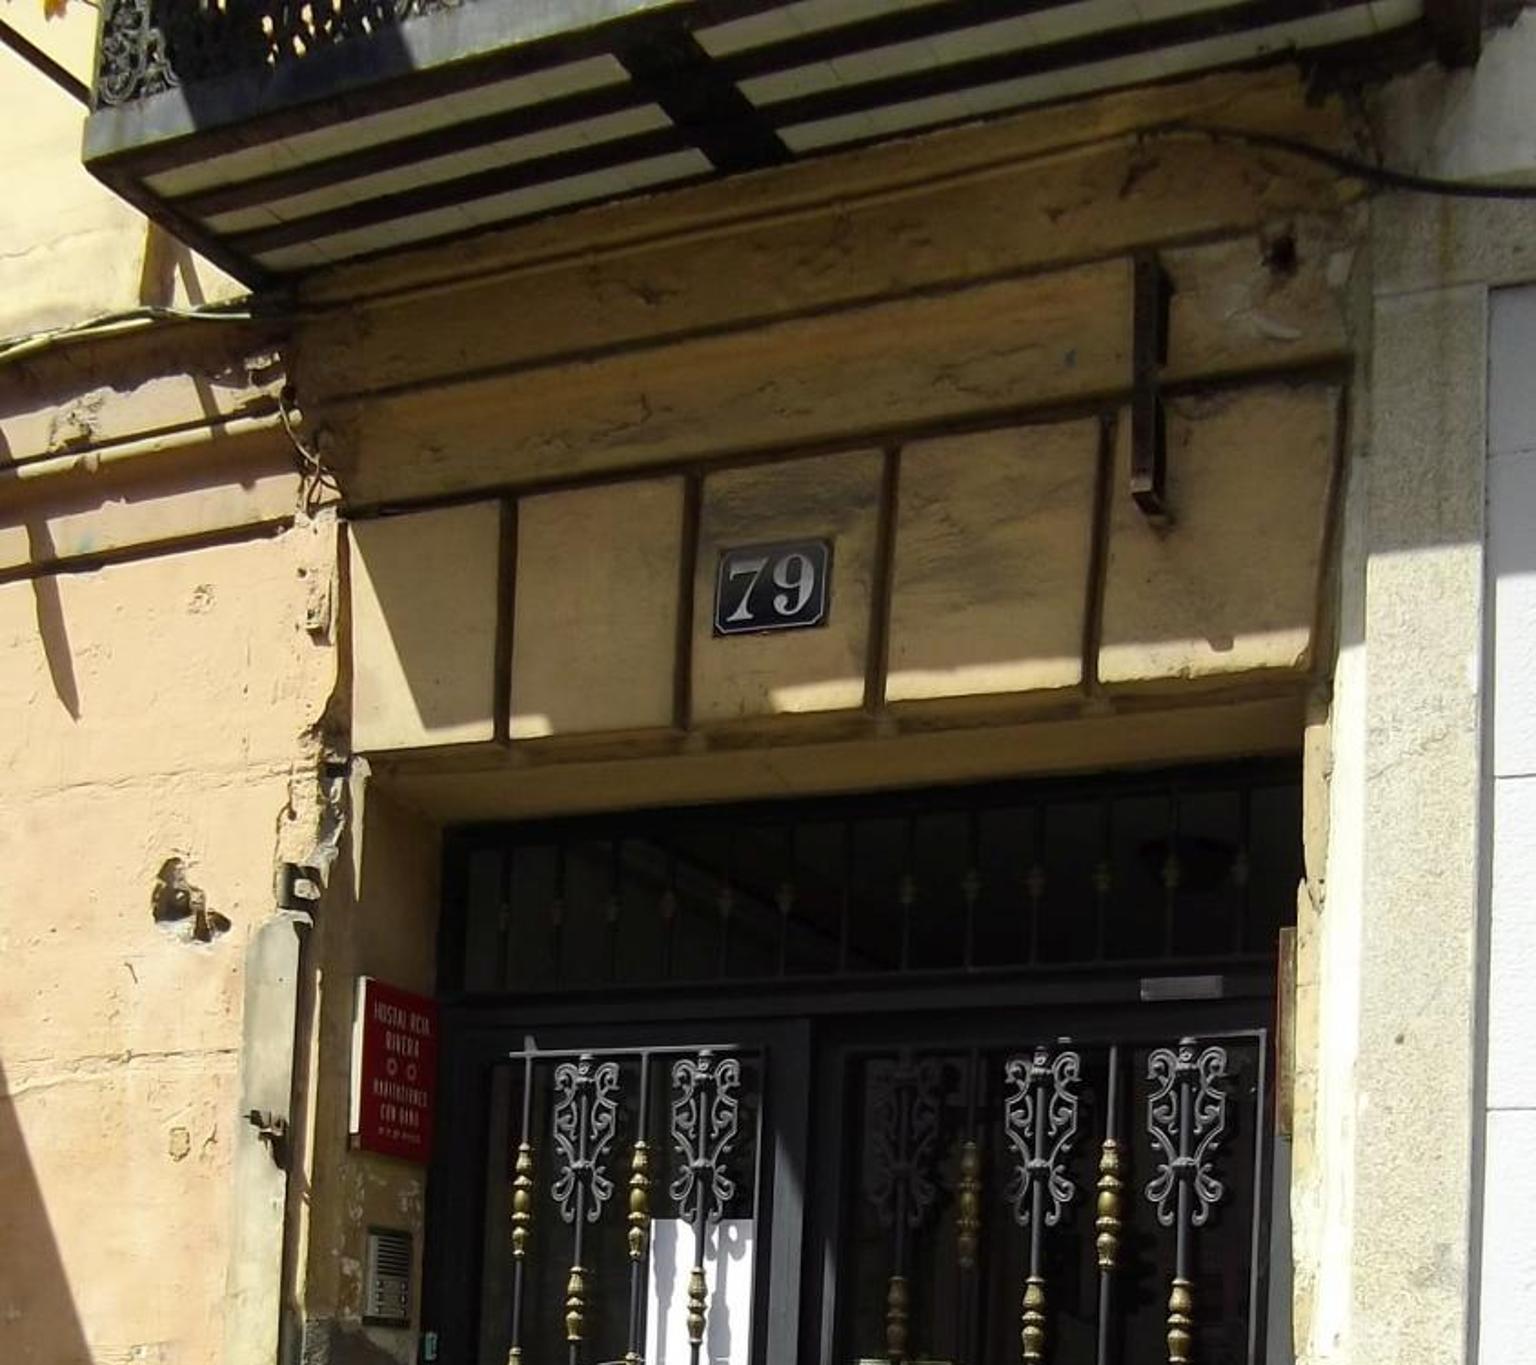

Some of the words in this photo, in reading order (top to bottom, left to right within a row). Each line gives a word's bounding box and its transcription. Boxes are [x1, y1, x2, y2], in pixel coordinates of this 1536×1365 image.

[726, 553, 815, 622] 79
[373, 1001, 407, 1031] HOSTAL
[385, 1031, 420, 1058] RIVERA
[380, 1103, 397, 1122] CON
